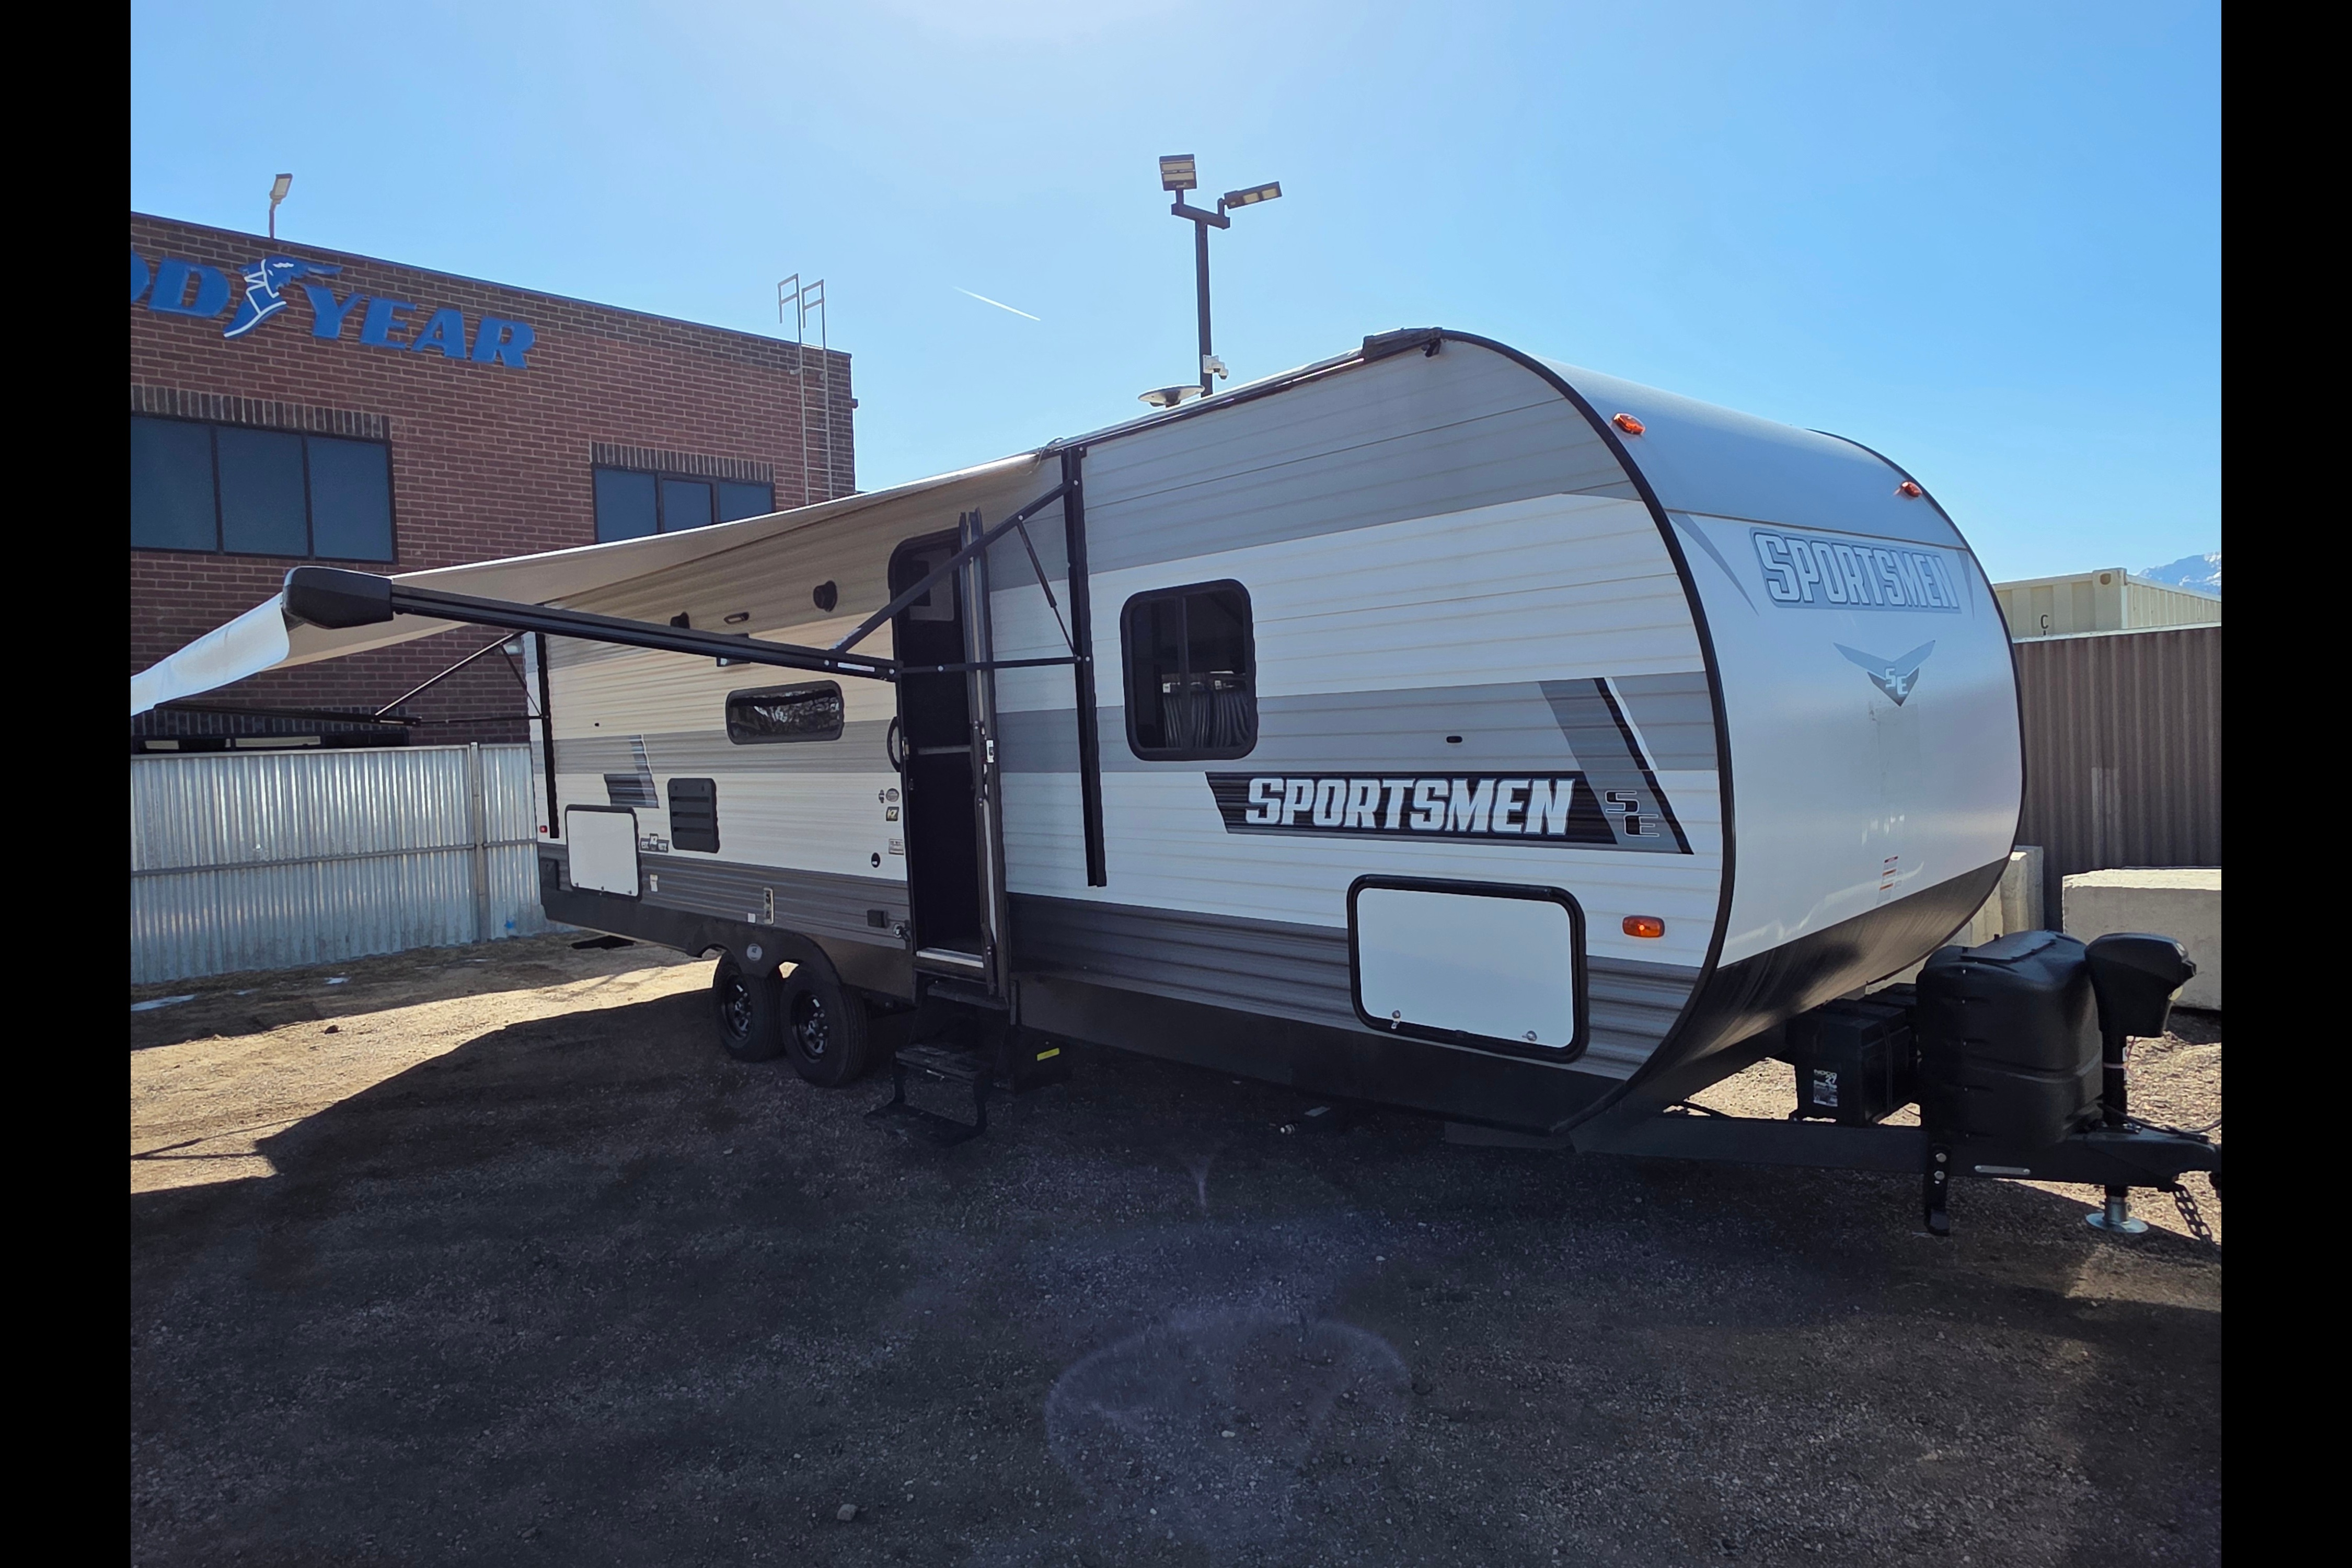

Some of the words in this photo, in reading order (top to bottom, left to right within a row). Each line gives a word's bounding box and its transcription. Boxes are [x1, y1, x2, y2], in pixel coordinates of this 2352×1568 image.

[131, 250, 230, 319] D
[302, 283, 535, 370] YEAR
[1753, 532, 1960, 609] SPORTSMEN
[2040, 614, 2049, 636] C
[1885, 667, 1909, 696] SE
[1246, 777, 1575, 836] SPORTSMEN
[1605, 790, 1660, 837] SE
